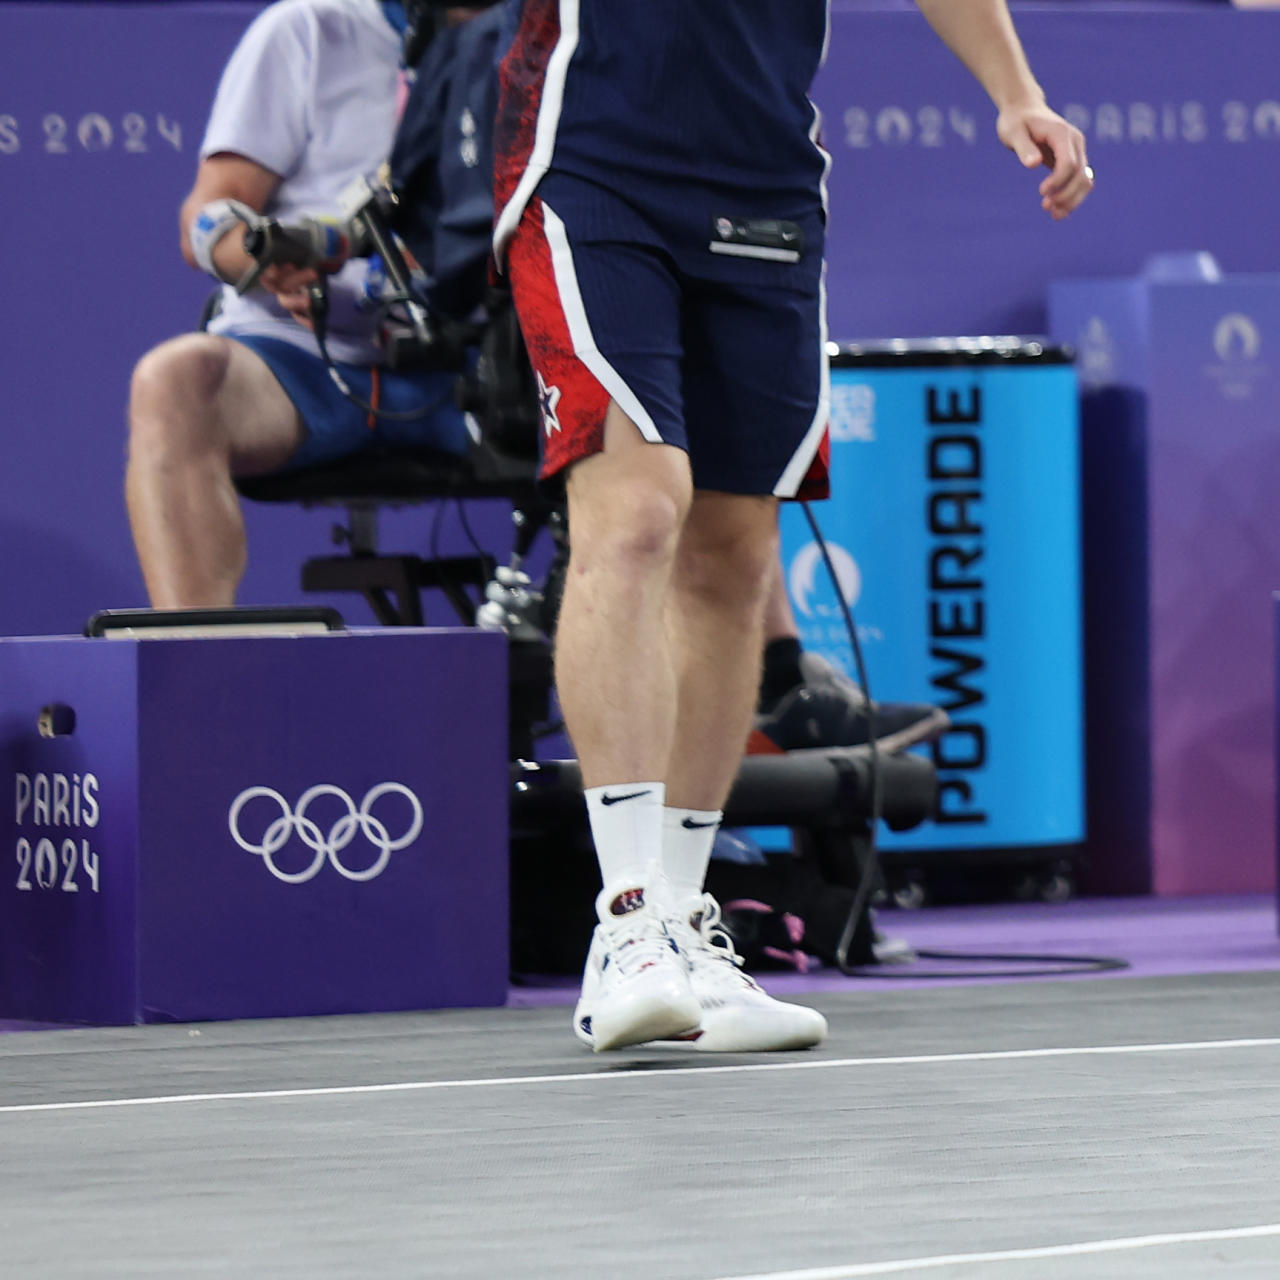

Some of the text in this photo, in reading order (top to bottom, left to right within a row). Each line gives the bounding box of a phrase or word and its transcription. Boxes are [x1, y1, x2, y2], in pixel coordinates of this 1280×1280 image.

[42, 111, 184, 153] 2024
[926, 384, 987, 824] POWERADE
[15, 838, 100, 892] 2024
